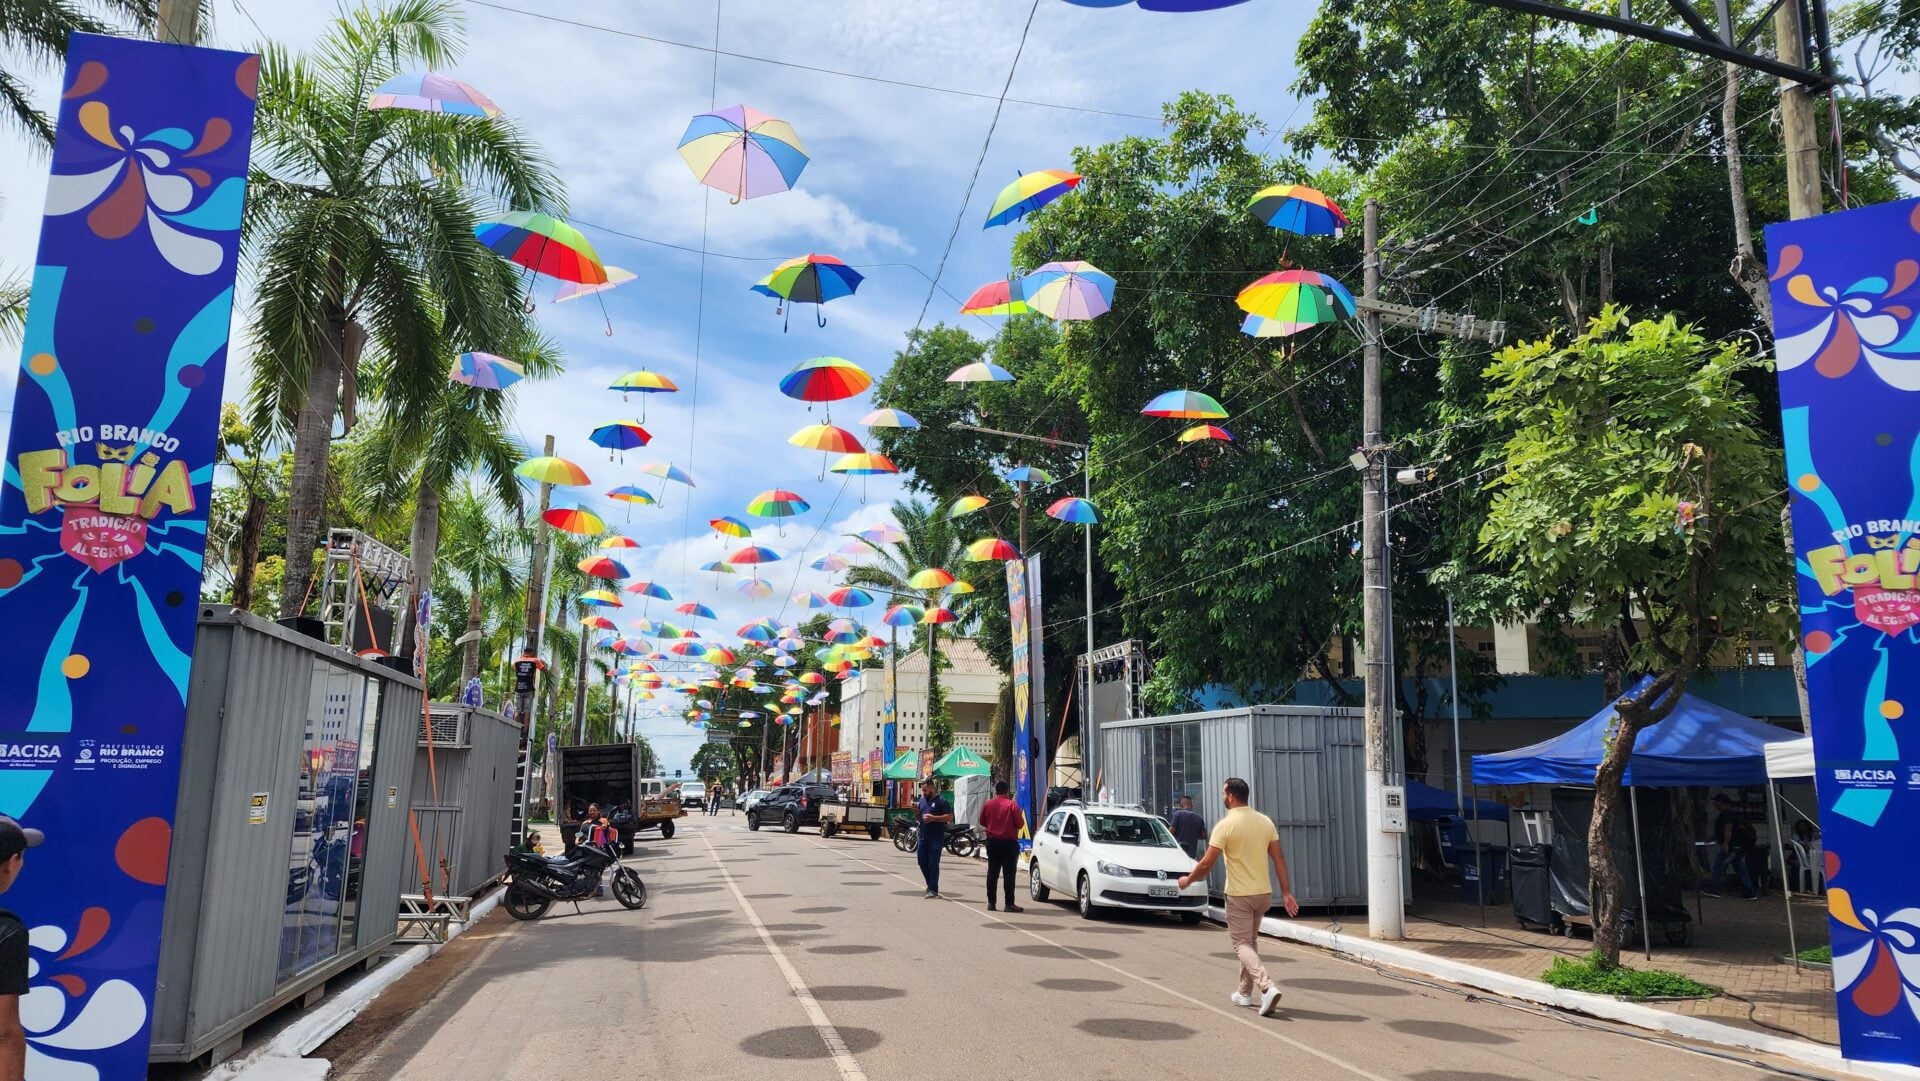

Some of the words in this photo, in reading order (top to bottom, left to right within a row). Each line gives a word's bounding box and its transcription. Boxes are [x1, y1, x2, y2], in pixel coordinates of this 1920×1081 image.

[56, 426, 94, 447] RIO
[100, 424, 180, 453] BRANCO
[68, 516, 142, 534] TRADIÇÃO
[1832, 524, 1863, 543] RIO
[1866, 519, 1920, 534] BRANC
[99, 531, 109, 542] E
[71, 542, 134, 558] ALEGRIA
[1866, 612, 1919, 625] ALEGRIA
[7, 744, 62, 758] ACISA
[99, 748, 119, 756] RIO
[120, 749, 165, 757] BRANCO
[1852, 769, 1897, 780] ACISA
